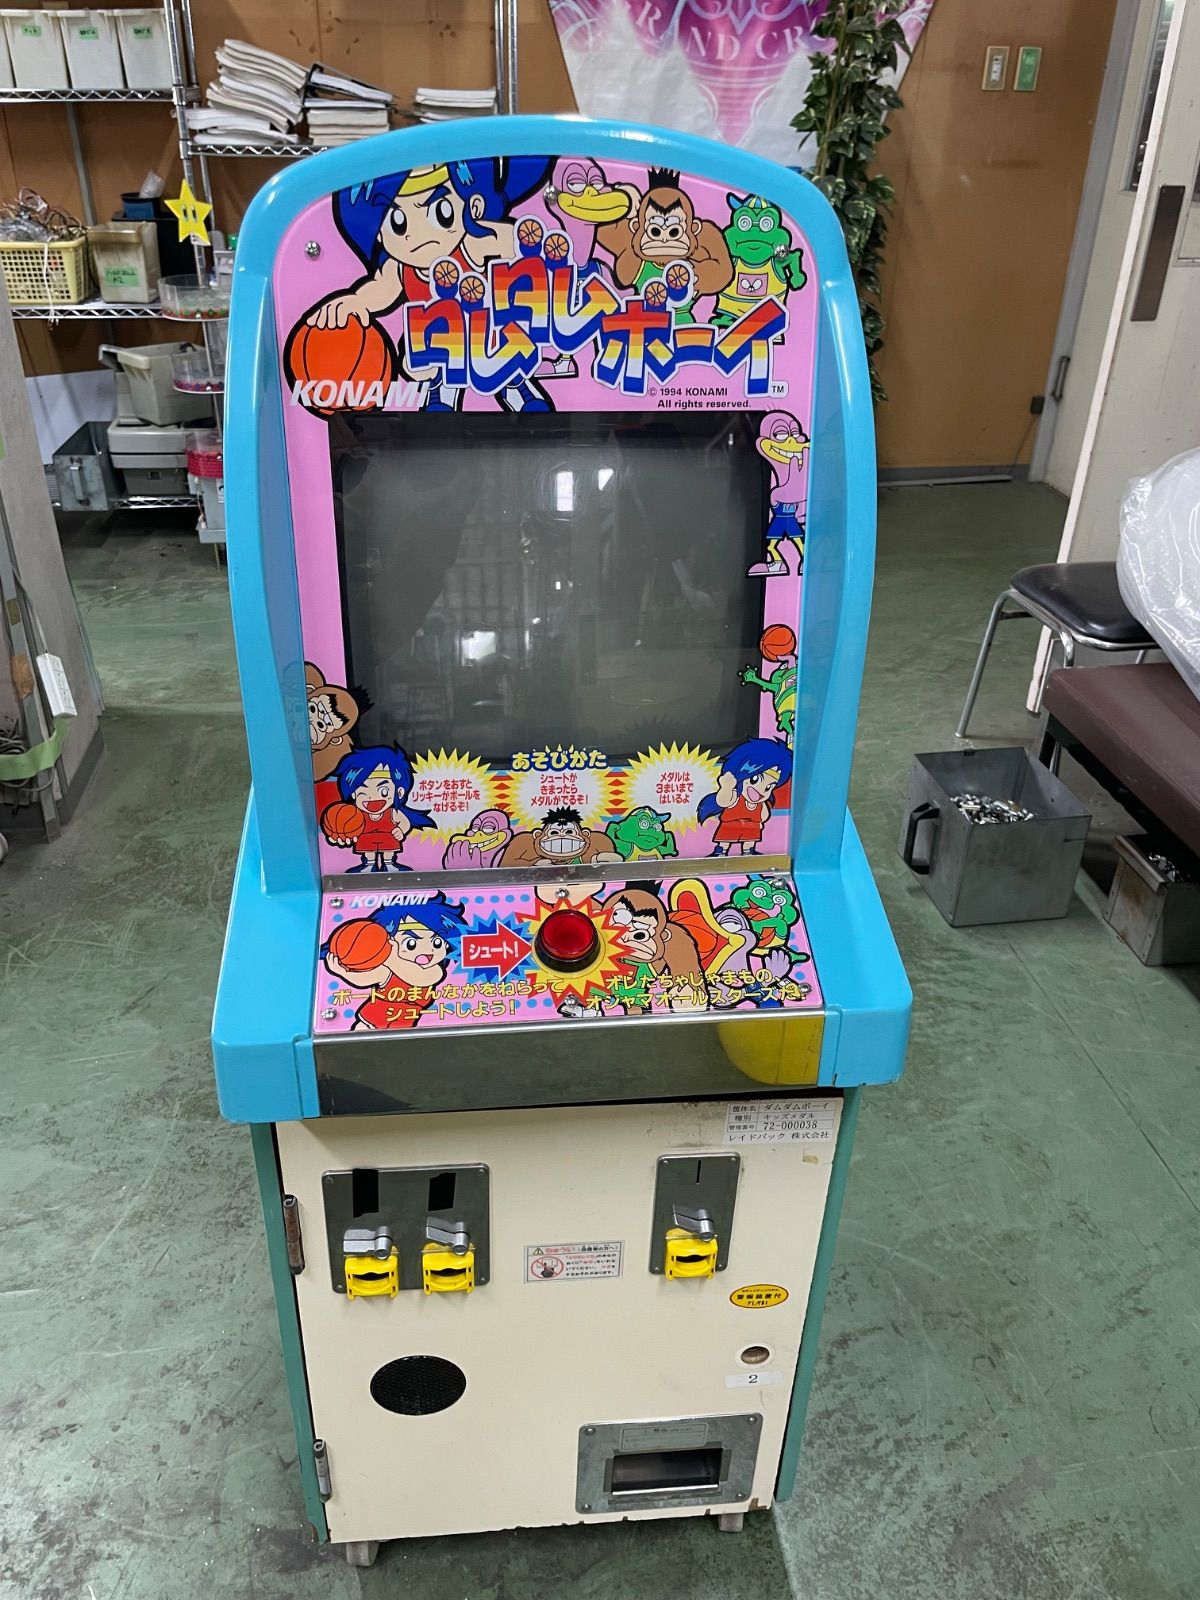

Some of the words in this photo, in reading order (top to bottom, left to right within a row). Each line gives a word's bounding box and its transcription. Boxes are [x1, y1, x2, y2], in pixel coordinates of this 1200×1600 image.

[290, 379, 430, 408] KONAMI
[660, 387, 682, 396] 1994
[685, 387, 728, 396] KONAMI
[657, 399, 671, 408] All
[674, 399, 703, 410] rights
[706, 399, 752, 408] reserved.
[510, 749, 608, 771] あそびかた
[540, 773, 578, 784] シュートが
[660, 771, 690, 782] メダルは
[419, 778, 473, 791] ボタンをおすと
[540, 783, 578, 795] きまったら
[656, 782, 694, 793] 3まいまで
[412, 789, 481, 802] リッキーがボールを
[530, 793, 589, 806] メダルがでるぞ!
[660, 793, 690, 804] はいるよ
[433, 801, 469, 813] なげるぞ!
[350, 893, 430, 909] KONAMI
[468, 941, 520, 961] シュート!
[332, 978, 565, 1007] ボードのまんなかをねらって
[385, 1001, 517, 1022] シュートしよう!
[763, 1120, 818, 1131] 72-000038
[791, 1131, 830, 1140] 株式会社
[748, 1374, 758, 1384] 2
